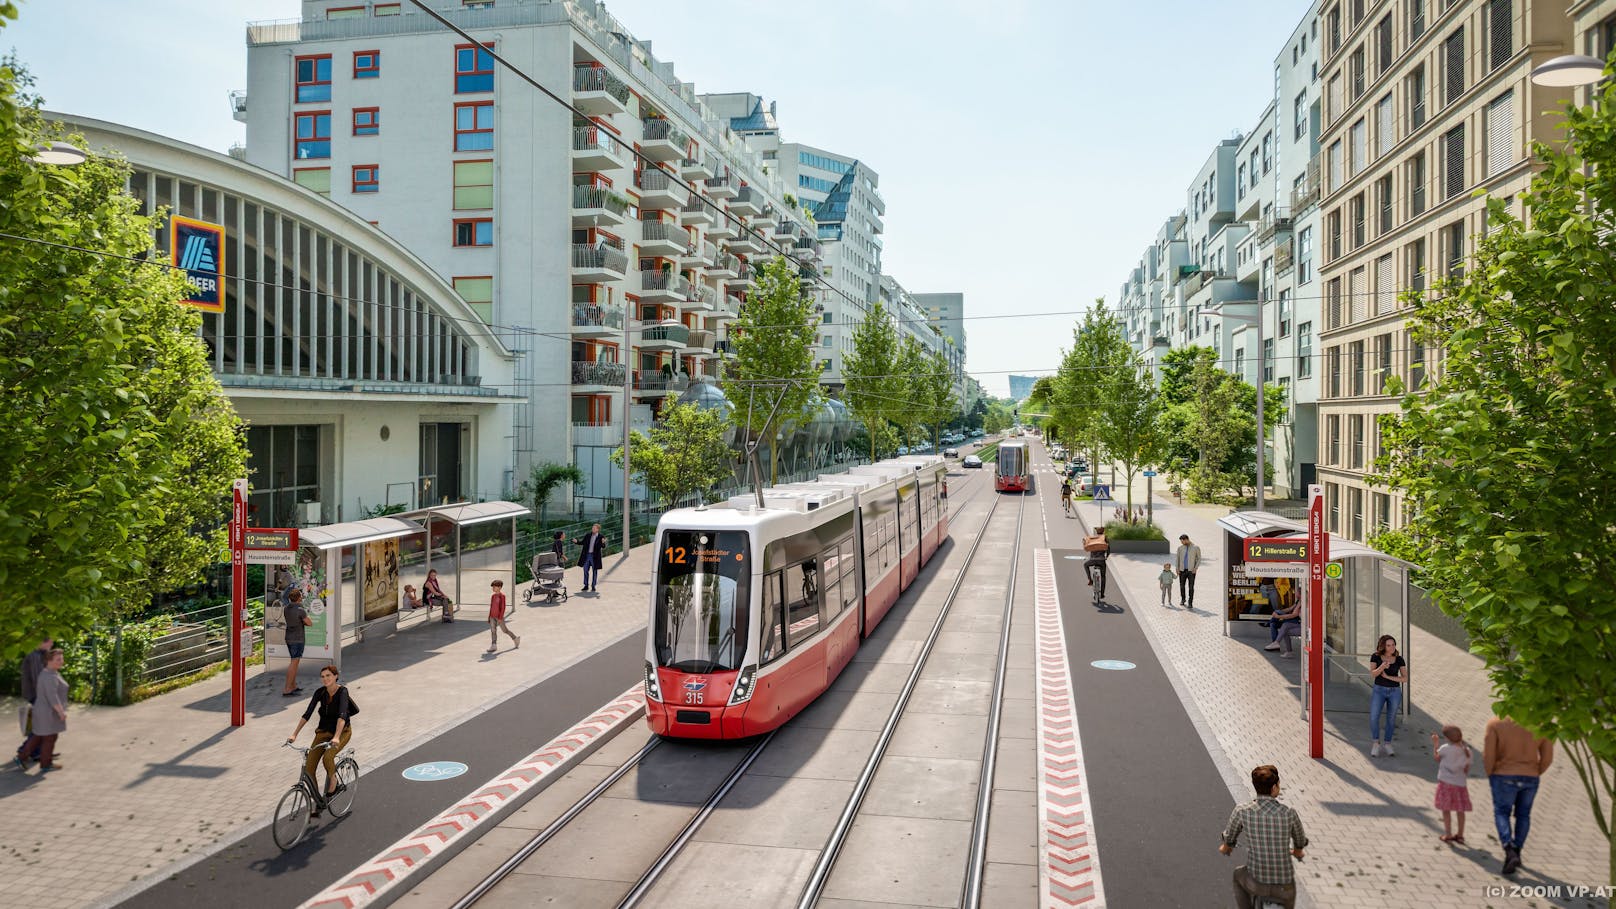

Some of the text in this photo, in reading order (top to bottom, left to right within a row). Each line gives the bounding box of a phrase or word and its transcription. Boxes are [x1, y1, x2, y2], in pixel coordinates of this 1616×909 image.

[246, 535, 255, 545] 12
[285, 536, 289, 546] 1
[665, 546, 686, 564] 12
[1249, 546, 1306, 557] 12 Hillerstraße 5
[1250, 566, 1305, 574] Haussteinstraße
[685, 691, 704, 705] 315
